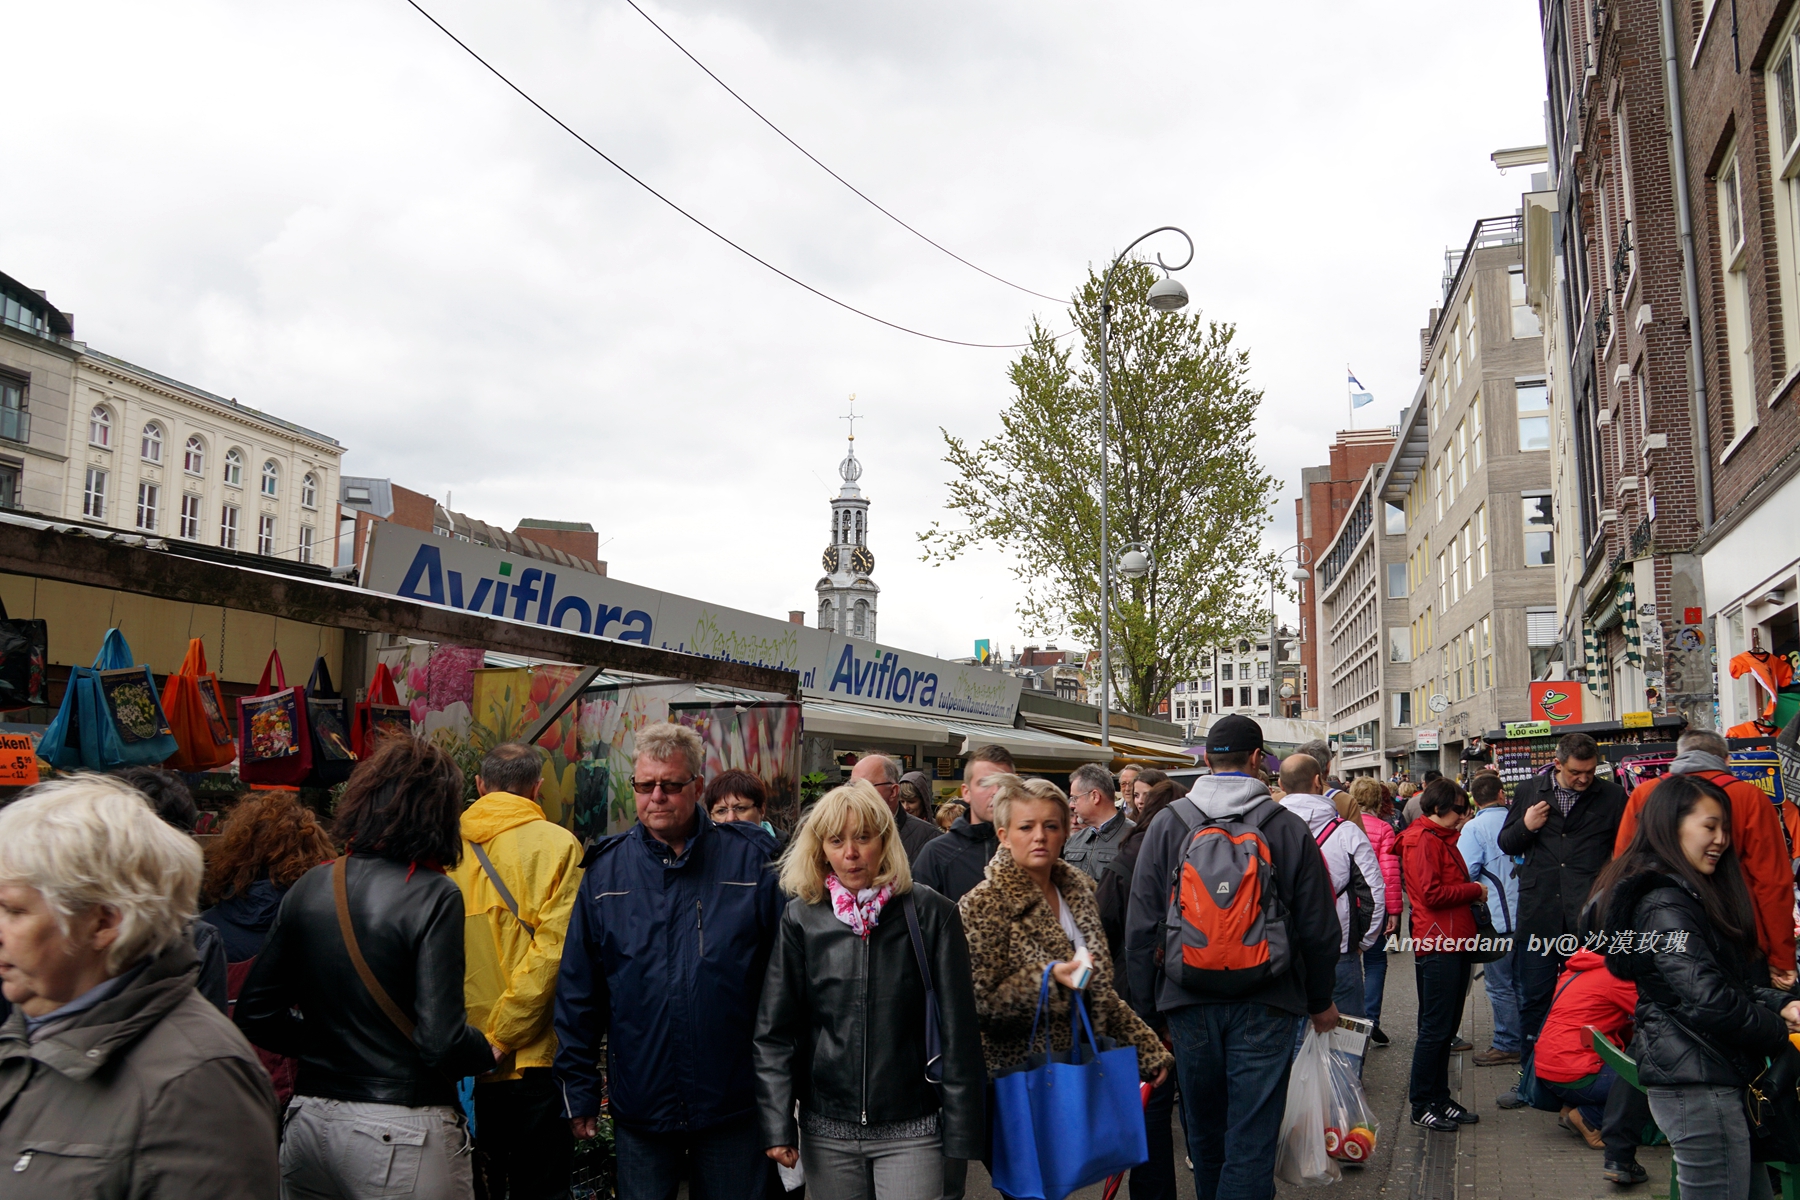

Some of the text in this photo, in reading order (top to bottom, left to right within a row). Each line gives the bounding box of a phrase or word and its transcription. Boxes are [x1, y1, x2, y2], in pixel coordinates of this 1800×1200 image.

[397, 543, 654, 647] Aviflora
[829, 643, 939, 708] Aviflora
[938, 691, 1015, 719] tulpenuitamsterdam.nl
[1508, 729, 1527, 737] 1,00
[1740, 770, 1754, 779] City
